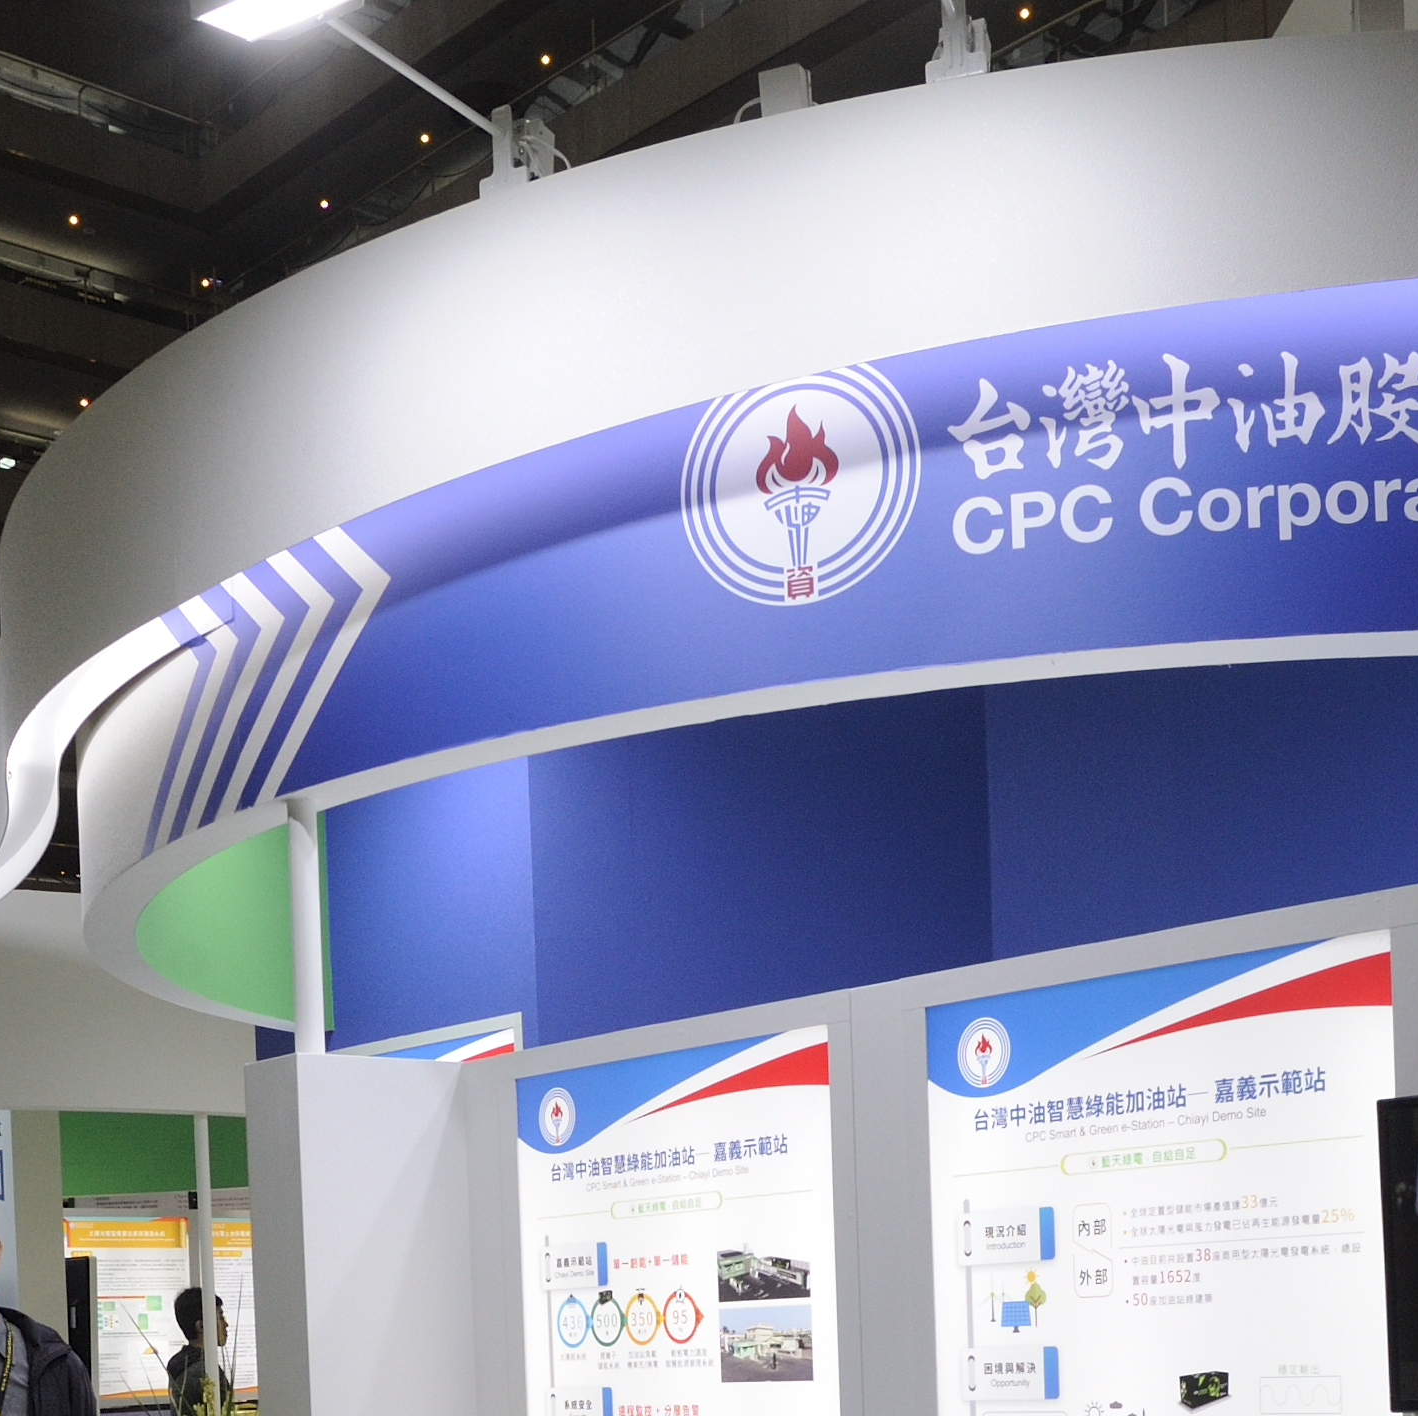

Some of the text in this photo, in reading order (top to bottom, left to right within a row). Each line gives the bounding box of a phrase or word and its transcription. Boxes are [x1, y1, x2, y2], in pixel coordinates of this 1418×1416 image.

[952, 482, 1114, 554] CPC
[1214, 1066, 1327, 1103] 嘉義示範站
[1025, 1106, 1267, 1143] CPC Smart & Green e-Station Chiayi Demo Site
[714, 1133, 789, 1163] 嘉義示範站
[586, 1180, 601, 1192] CPC
[602, 1178, 621, 1191] Smart
[629, 1175, 650, 1188] Green
[651, 1173, 681, 1186] e-Station
[689, 1169, 711, 1183] Chiayi
[712, 1166, 735, 1178] Demo
[735, 1164, 749, 1176] Site
[985, 1223, 1027, 1239] 現況介紹
[1078, 1218, 1107, 1237] 內部
[986, 1241, 1026, 1251] Introduction
[1079, 1268, 1108, 1286] 外部
[562, 1316, 584, 1330] 436
[596, 1315, 618, 1329] 500
[631, 1311, 653, 1327] 350
[672, 1310, 688, 1324] 95
[984, 1362, 1037, 1375] 困境與解決
[1279, 1363, 1321, 1375] 穩定輸出
[990, 1379, 1030, 1388] Opportunity
